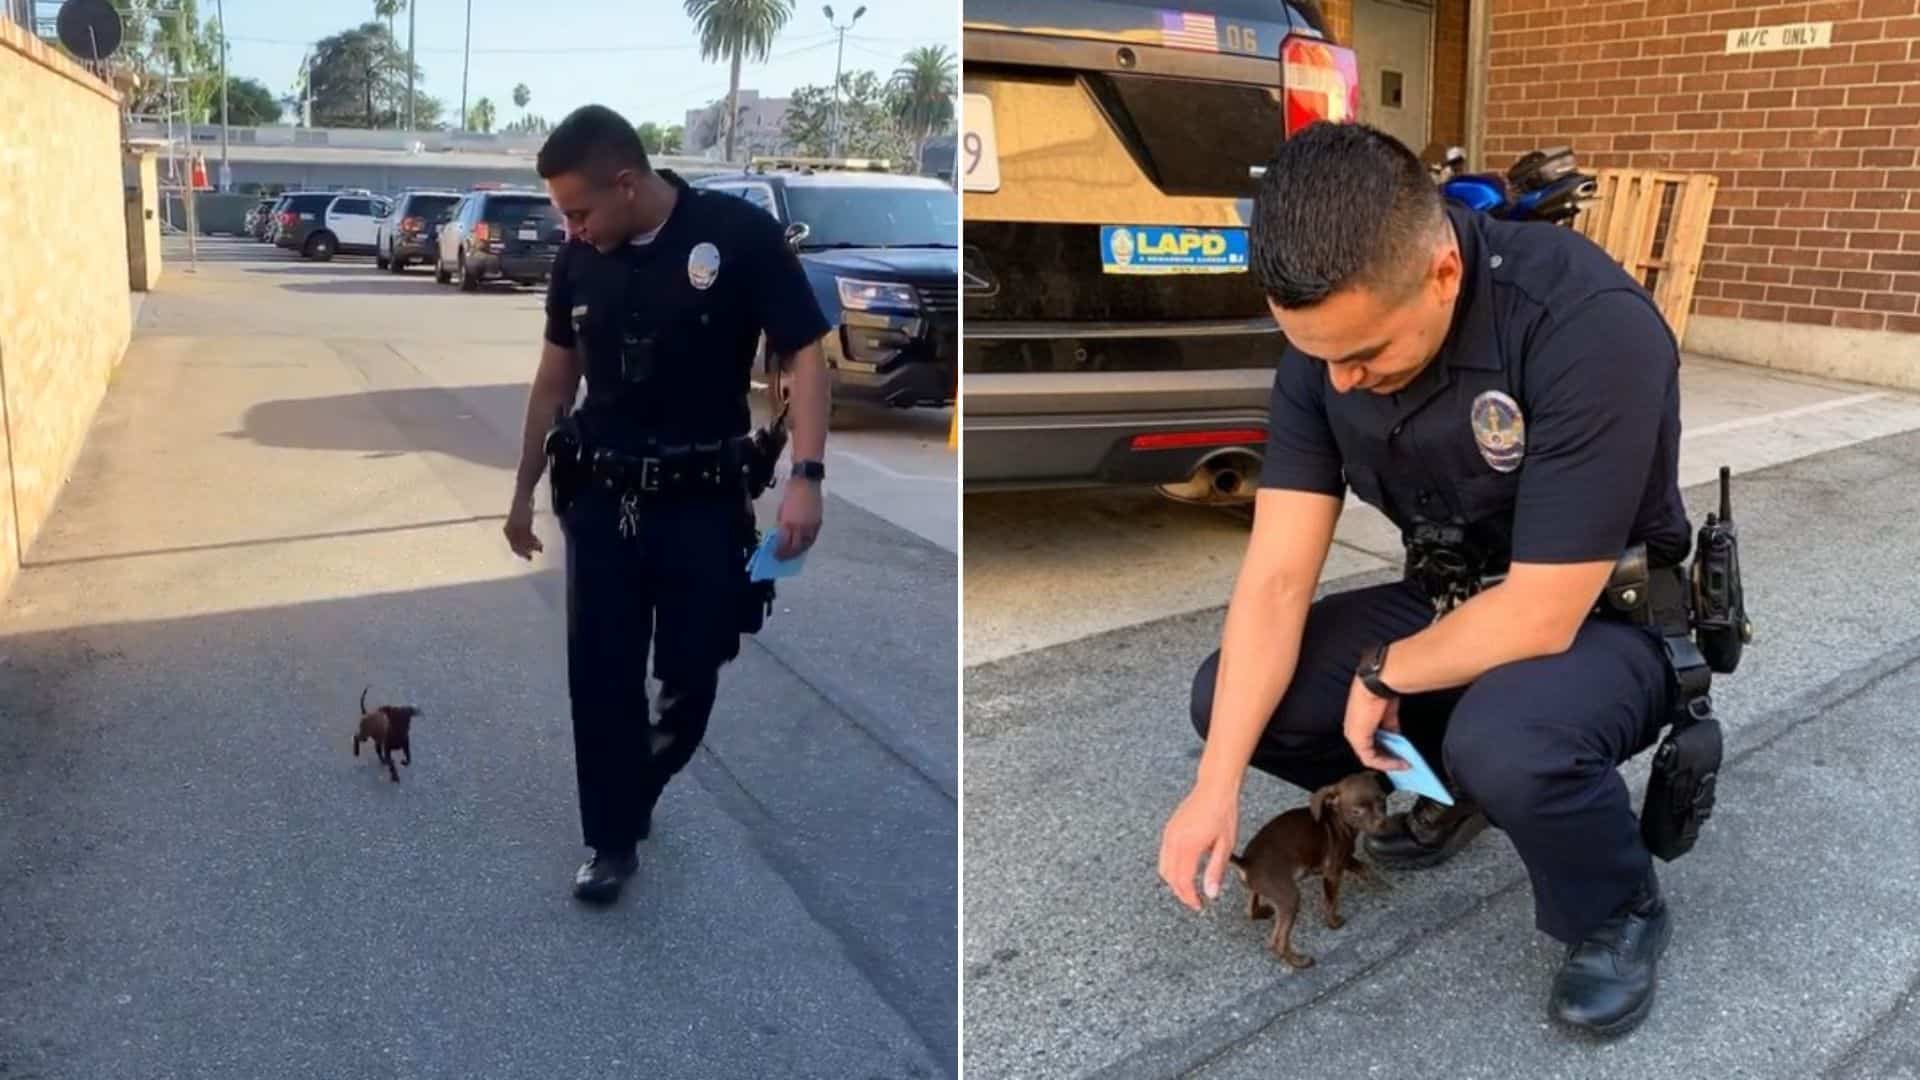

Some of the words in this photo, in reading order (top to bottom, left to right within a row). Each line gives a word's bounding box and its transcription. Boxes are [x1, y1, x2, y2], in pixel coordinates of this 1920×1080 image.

[1226, 25, 1257, 53] 06
[1782, 26, 1817, 46] ONLY
[1136, 232, 1227, 256] LAPD
